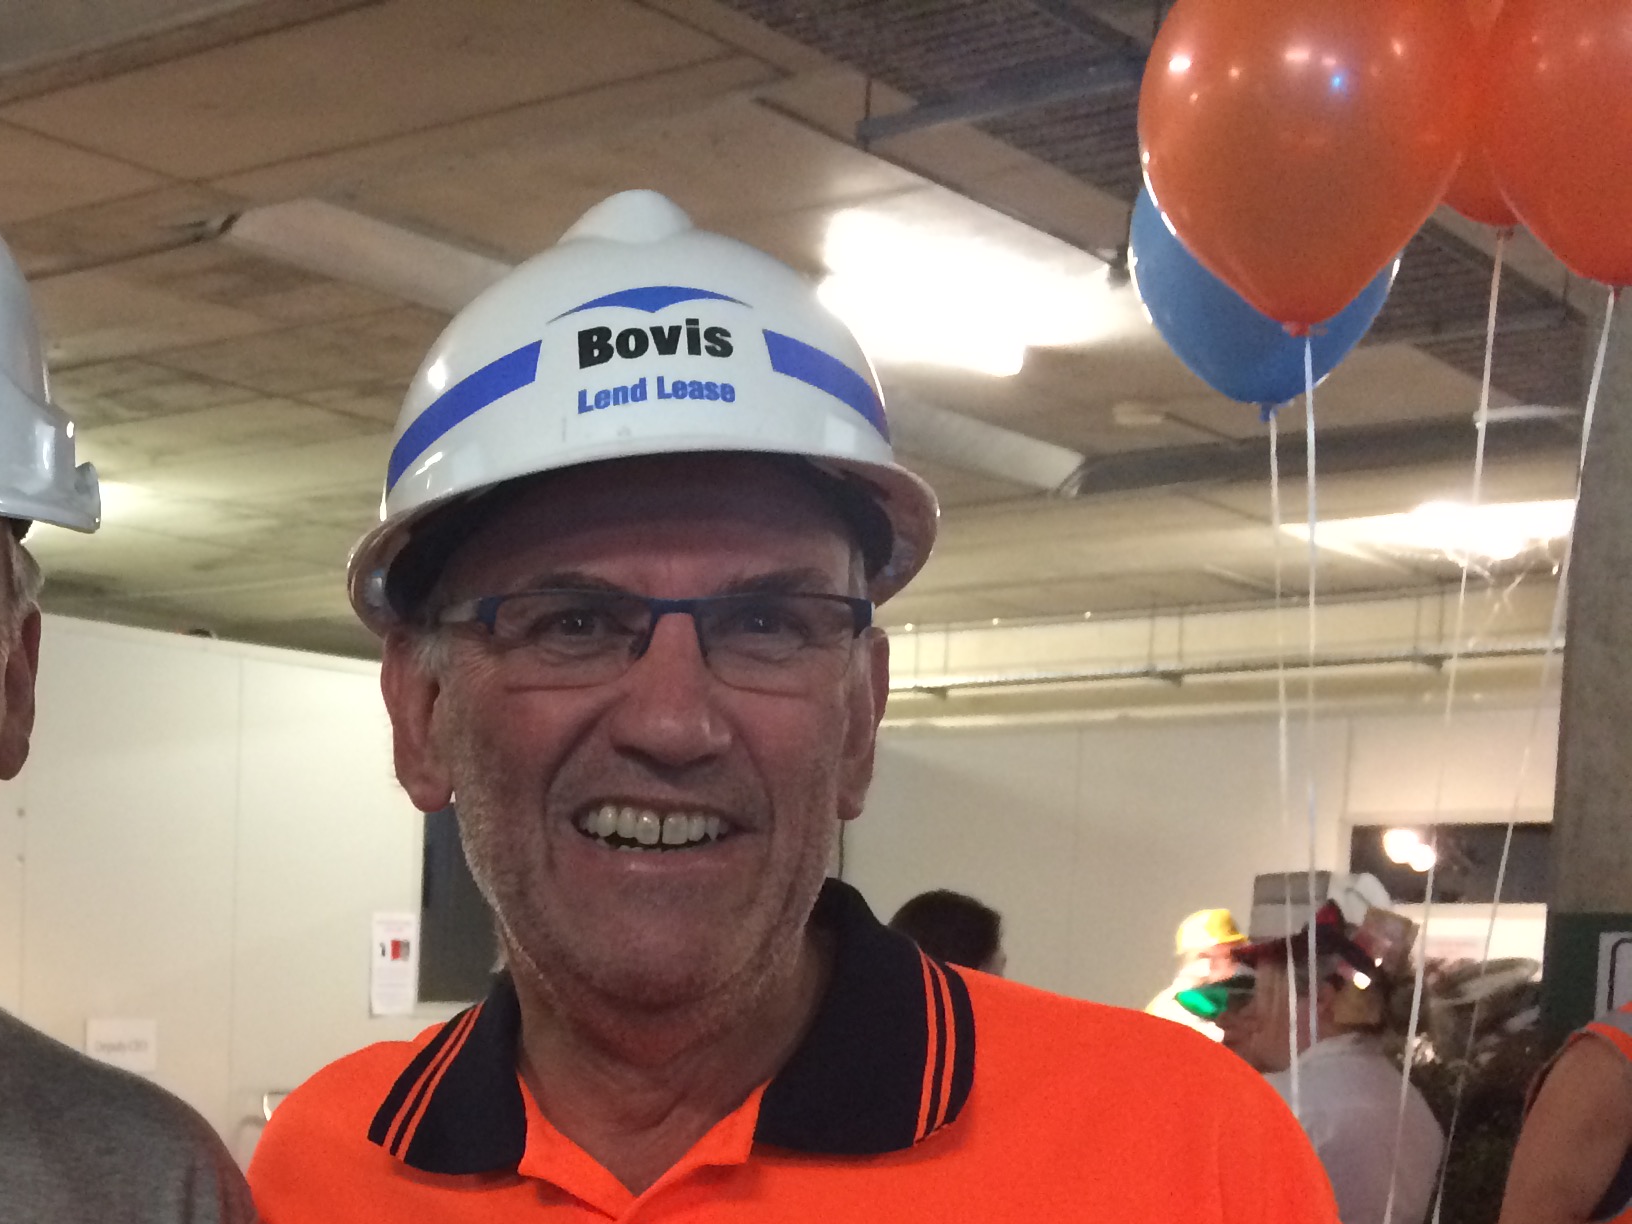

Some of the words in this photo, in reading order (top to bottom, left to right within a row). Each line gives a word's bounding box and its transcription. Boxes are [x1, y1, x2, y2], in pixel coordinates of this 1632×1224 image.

[577, 318, 734, 370] Bovis
[577, 377, 647, 415] Lend
[656, 375, 736, 403] Lease
